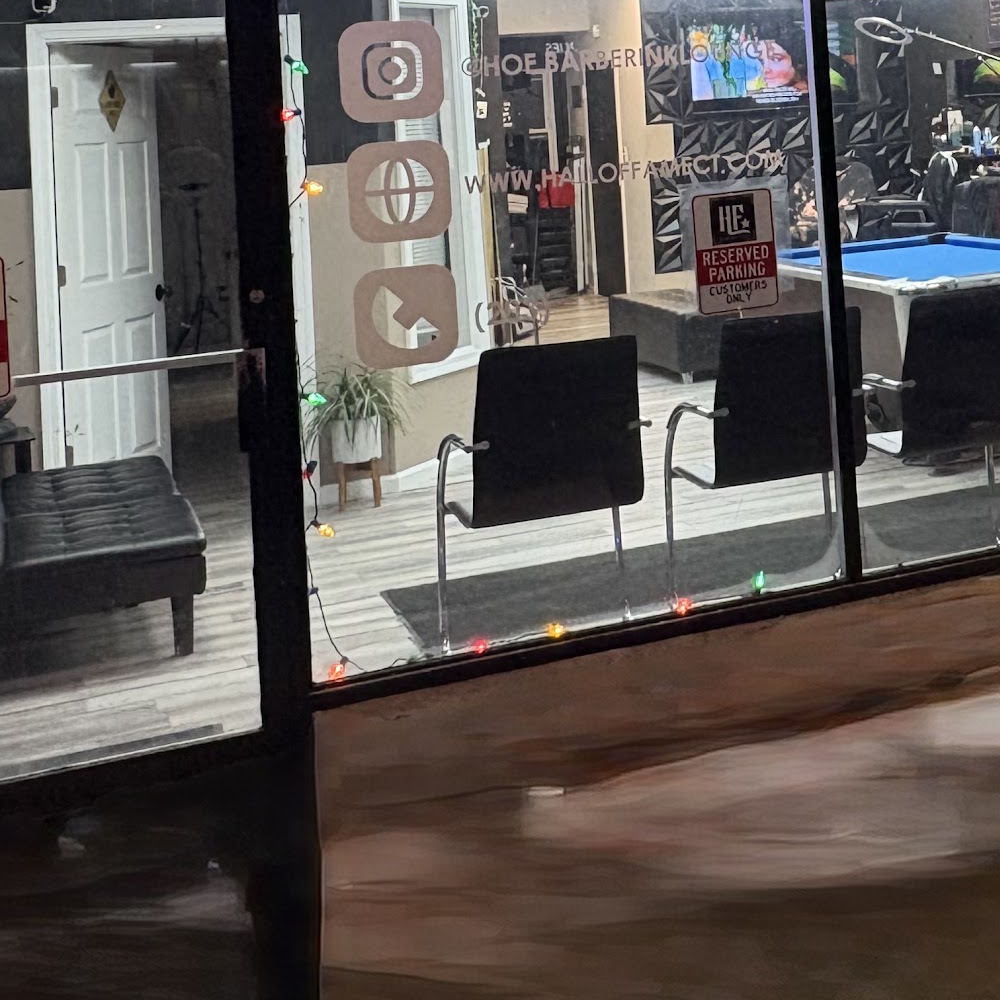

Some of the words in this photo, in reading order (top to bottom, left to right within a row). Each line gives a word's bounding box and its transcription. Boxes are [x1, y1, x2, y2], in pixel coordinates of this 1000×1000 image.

[702, 245, 769, 266] RESERVED
[709, 262, 766, 282] PARKING
[709, 280, 768, 296] CUSTOMERS
